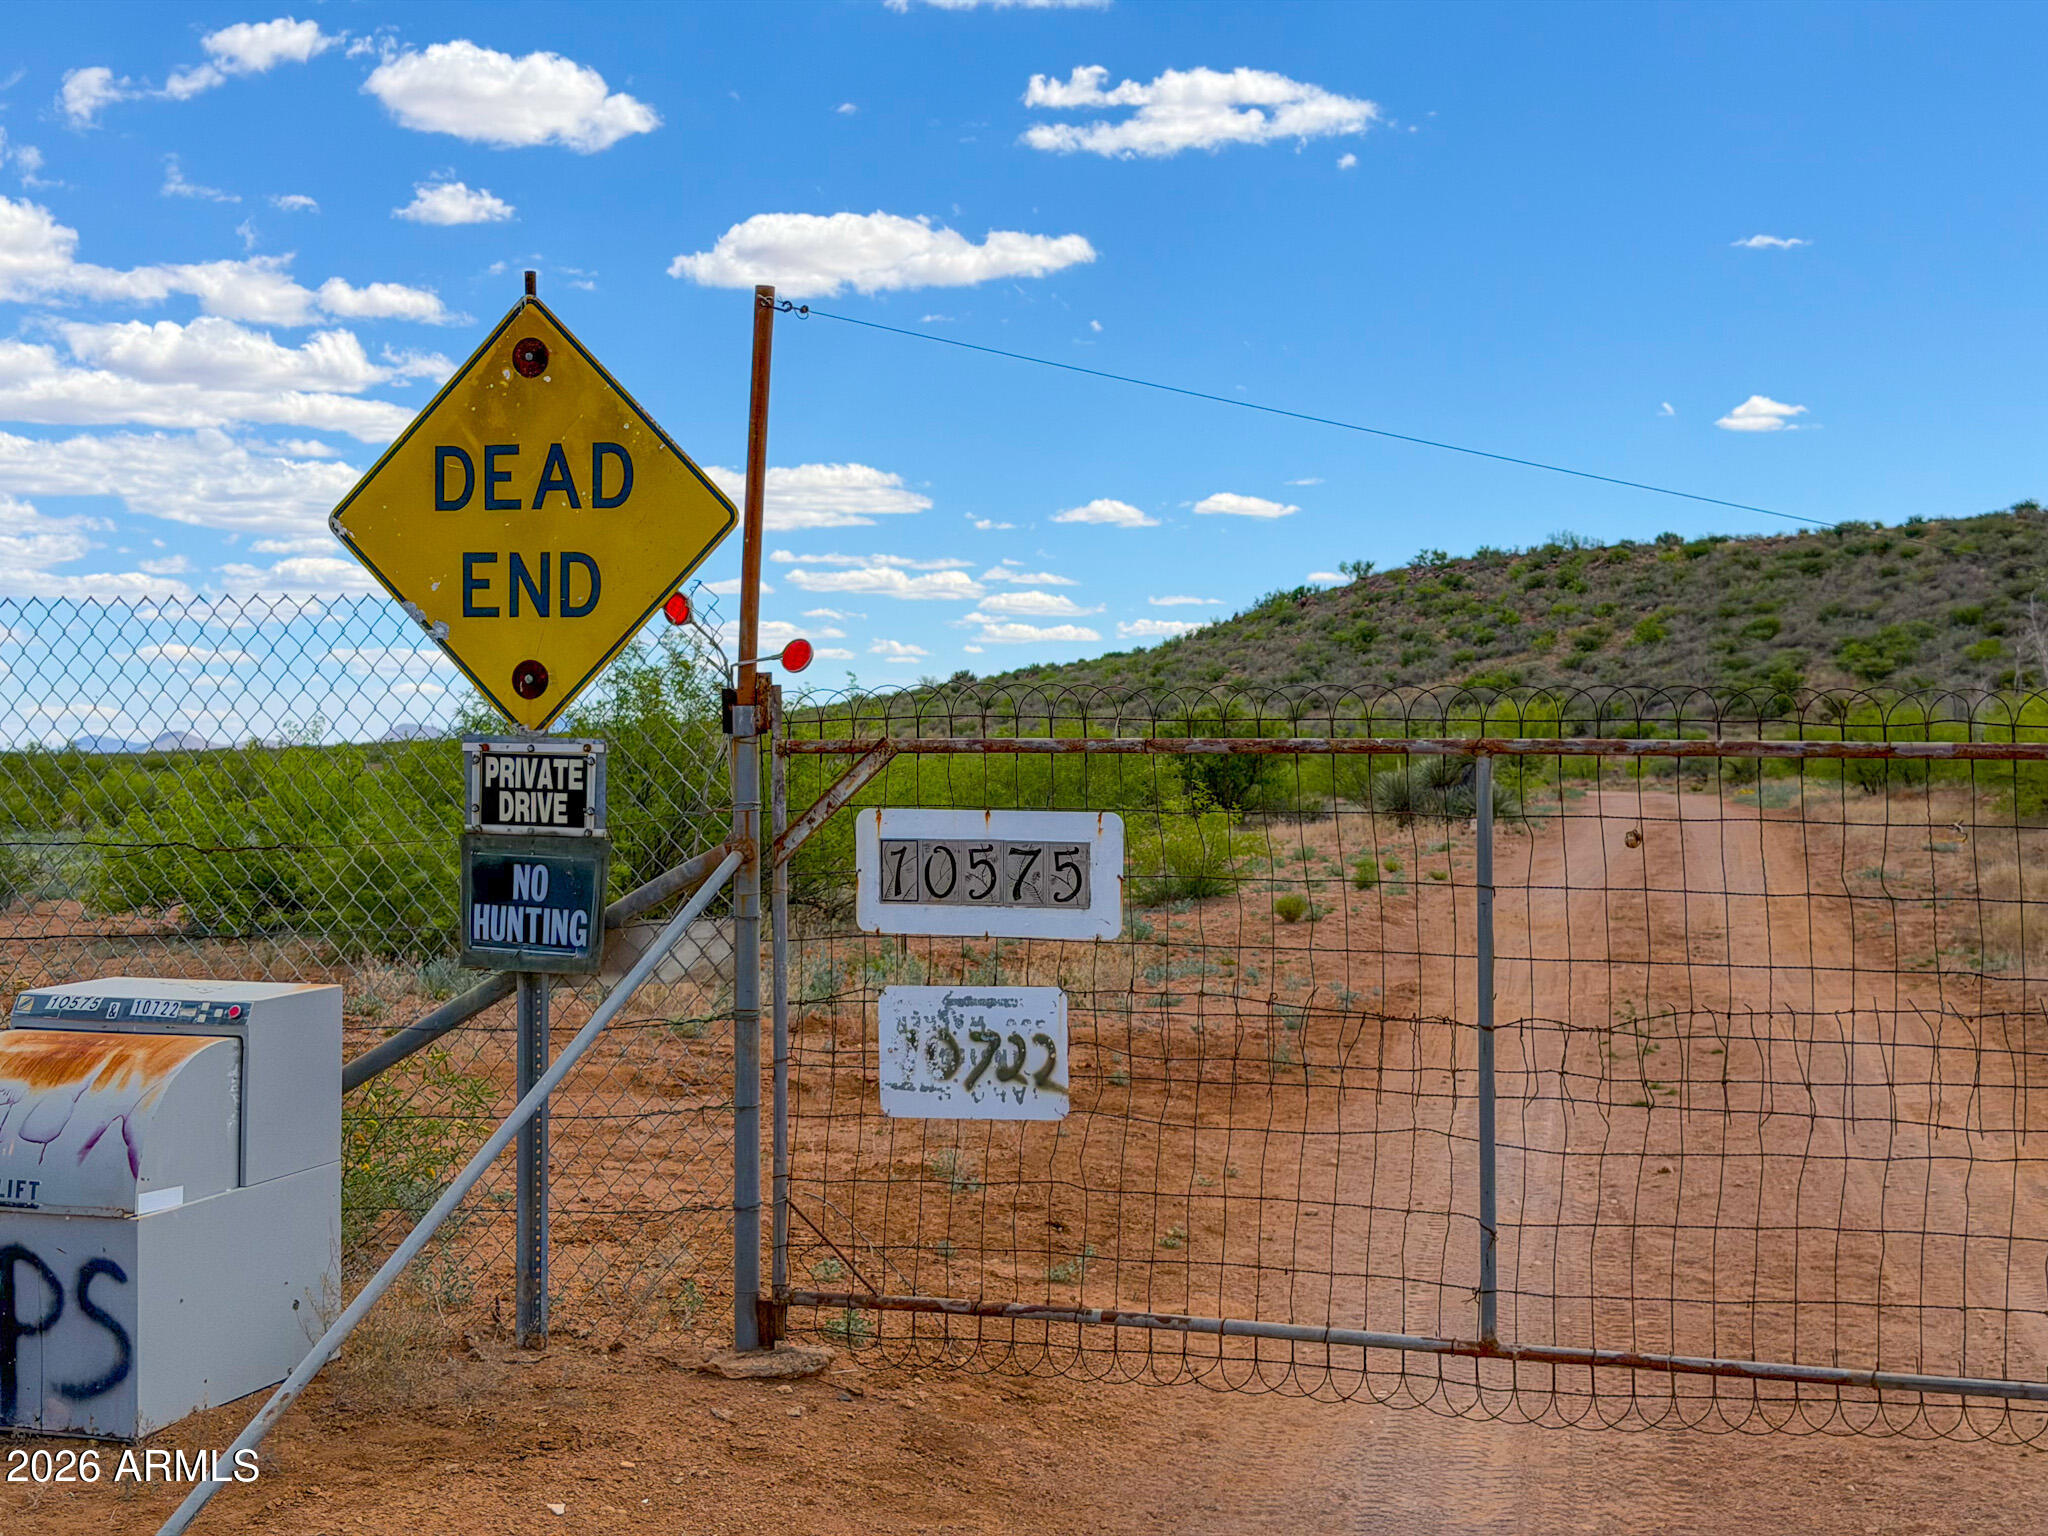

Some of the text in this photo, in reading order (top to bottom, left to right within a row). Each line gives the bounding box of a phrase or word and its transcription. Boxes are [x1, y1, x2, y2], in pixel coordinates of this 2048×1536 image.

[434, 442, 634, 511] DEAD
[462, 552, 601, 618] END
[484, 756, 584, 790] PRIVATE
[498, 791, 568, 824] DRIVE
[512, 863, 549, 902] NO
[890, 844, 1083, 903] 10575
[473, 903, 588, 948] HUNTING
[50, 996, 179, 1019] 10575 & 10722
